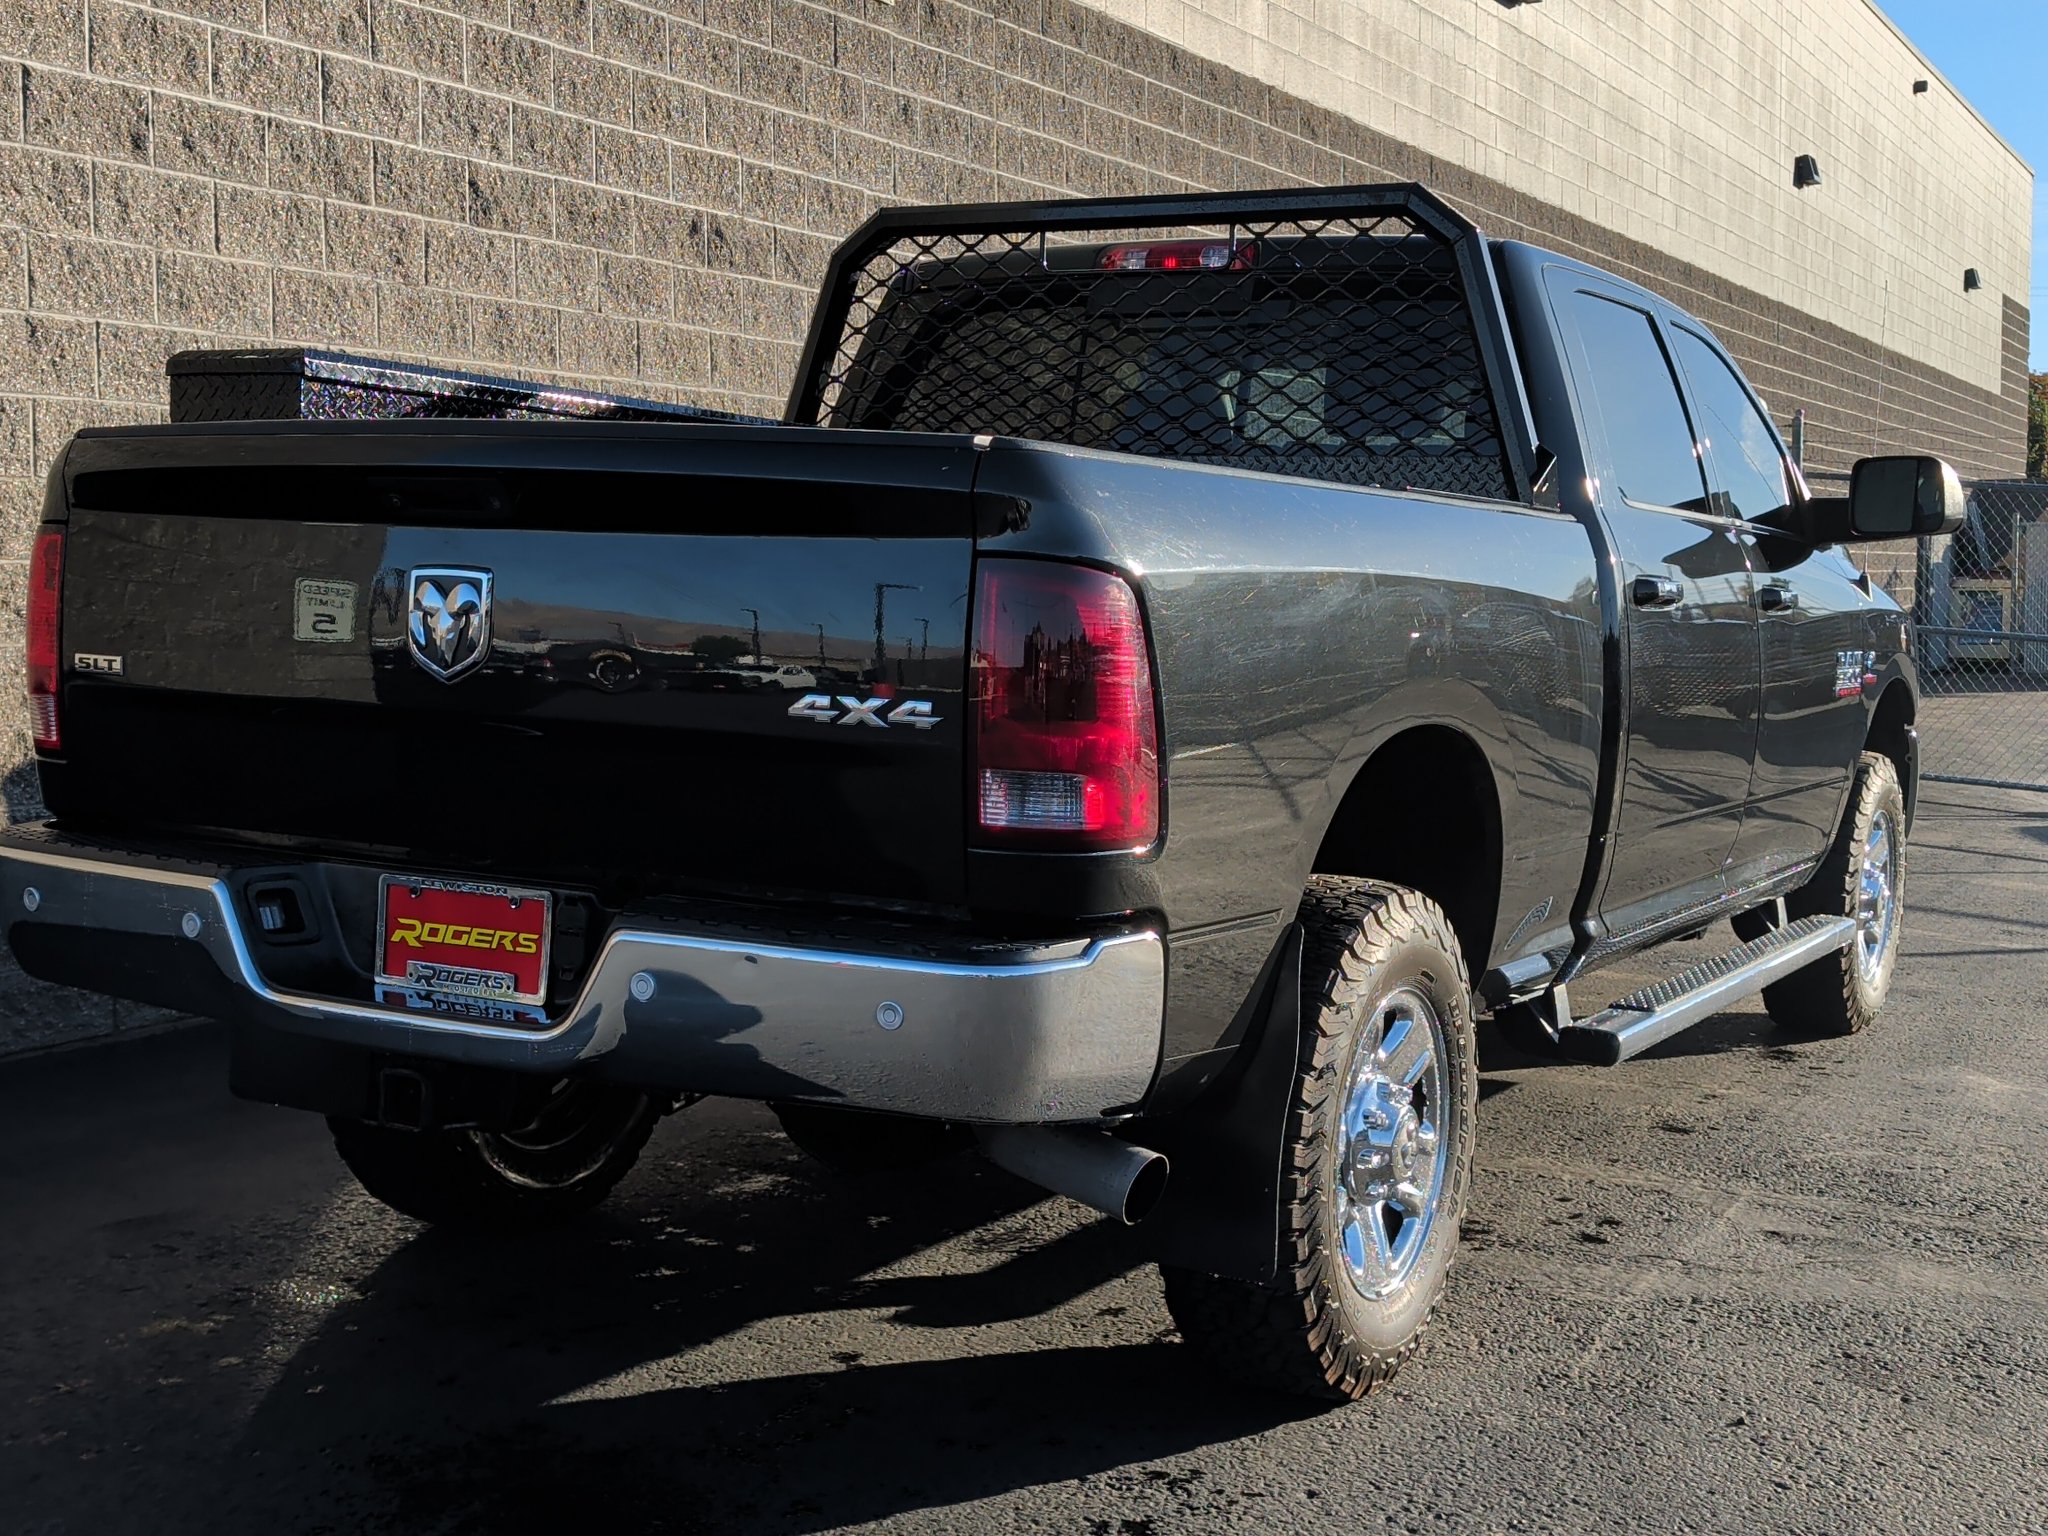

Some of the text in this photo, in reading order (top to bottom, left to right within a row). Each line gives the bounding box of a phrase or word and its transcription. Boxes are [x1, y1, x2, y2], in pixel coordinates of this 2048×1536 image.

[78, 656, 117, 671] SLT
[420, 879, 508, 896] LEWISTON
[390, 917, 540, 954] ROGERS
[414, 964, 505, 989] ROGERS
